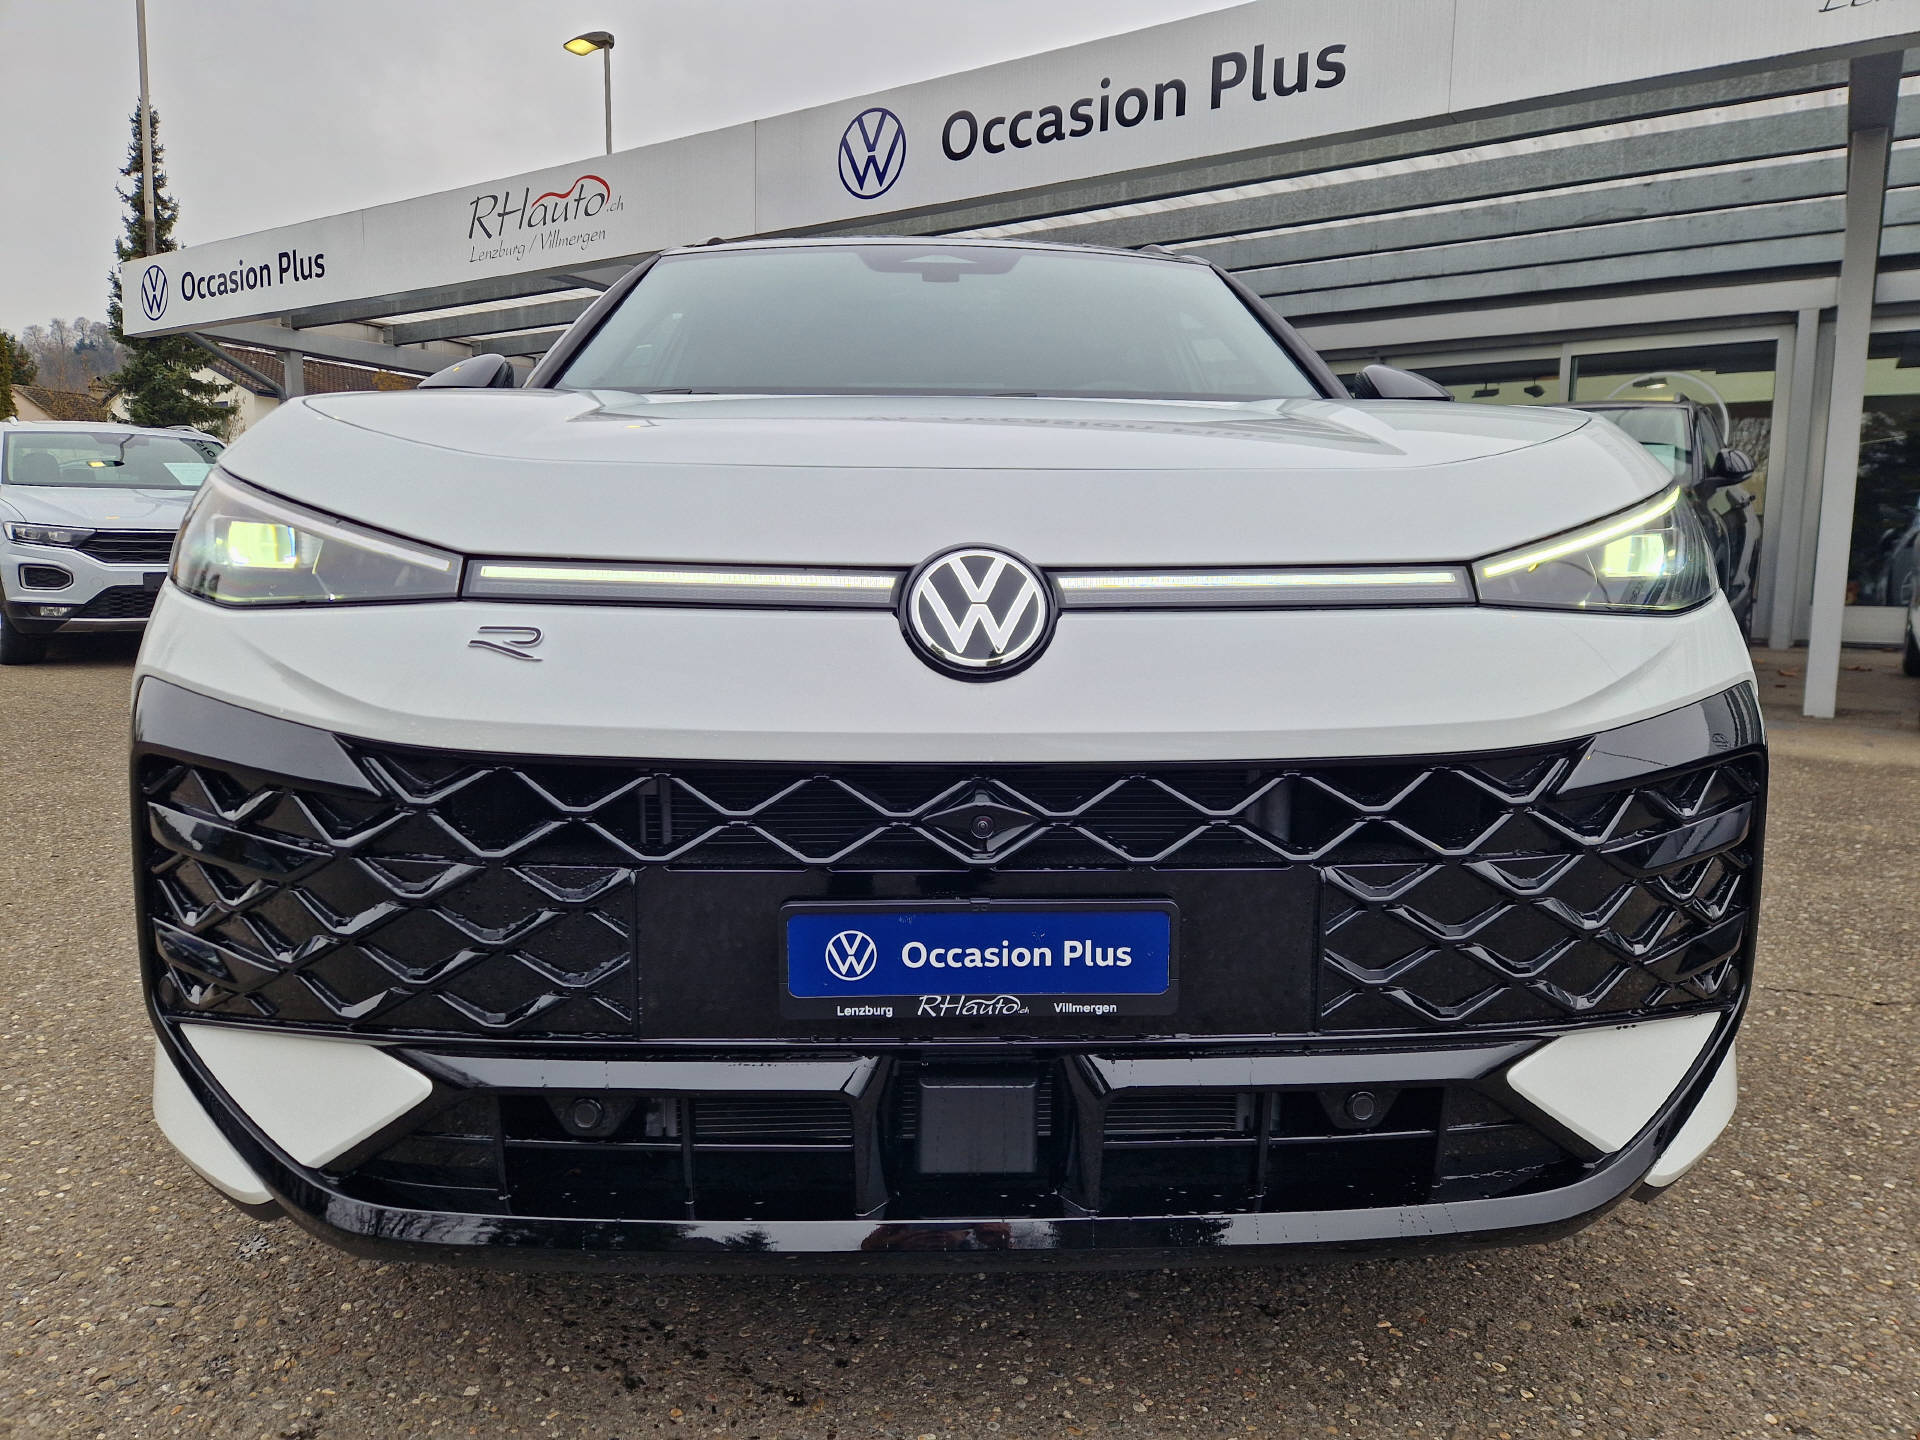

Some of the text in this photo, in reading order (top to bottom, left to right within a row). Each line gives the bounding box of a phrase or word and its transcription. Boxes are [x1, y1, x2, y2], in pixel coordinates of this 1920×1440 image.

[839, 43, 1347, 193] VW Occasion Plus
[468, 240, 527, 263] Lenzburg
[540, 229, 607, 251] Villmergen
[181, 259, 272, 302] Occasion
[278, 249, 325, 285] Plus
[918, 554, 1039, 655] VW
[901, 940, 1053, 969] Occasion
[1063, 940, 1132, 968] Plus
[836, 1005, 894, 1018] Lenzburg
[1053, 1002, 1118, 1015] Villmergen
